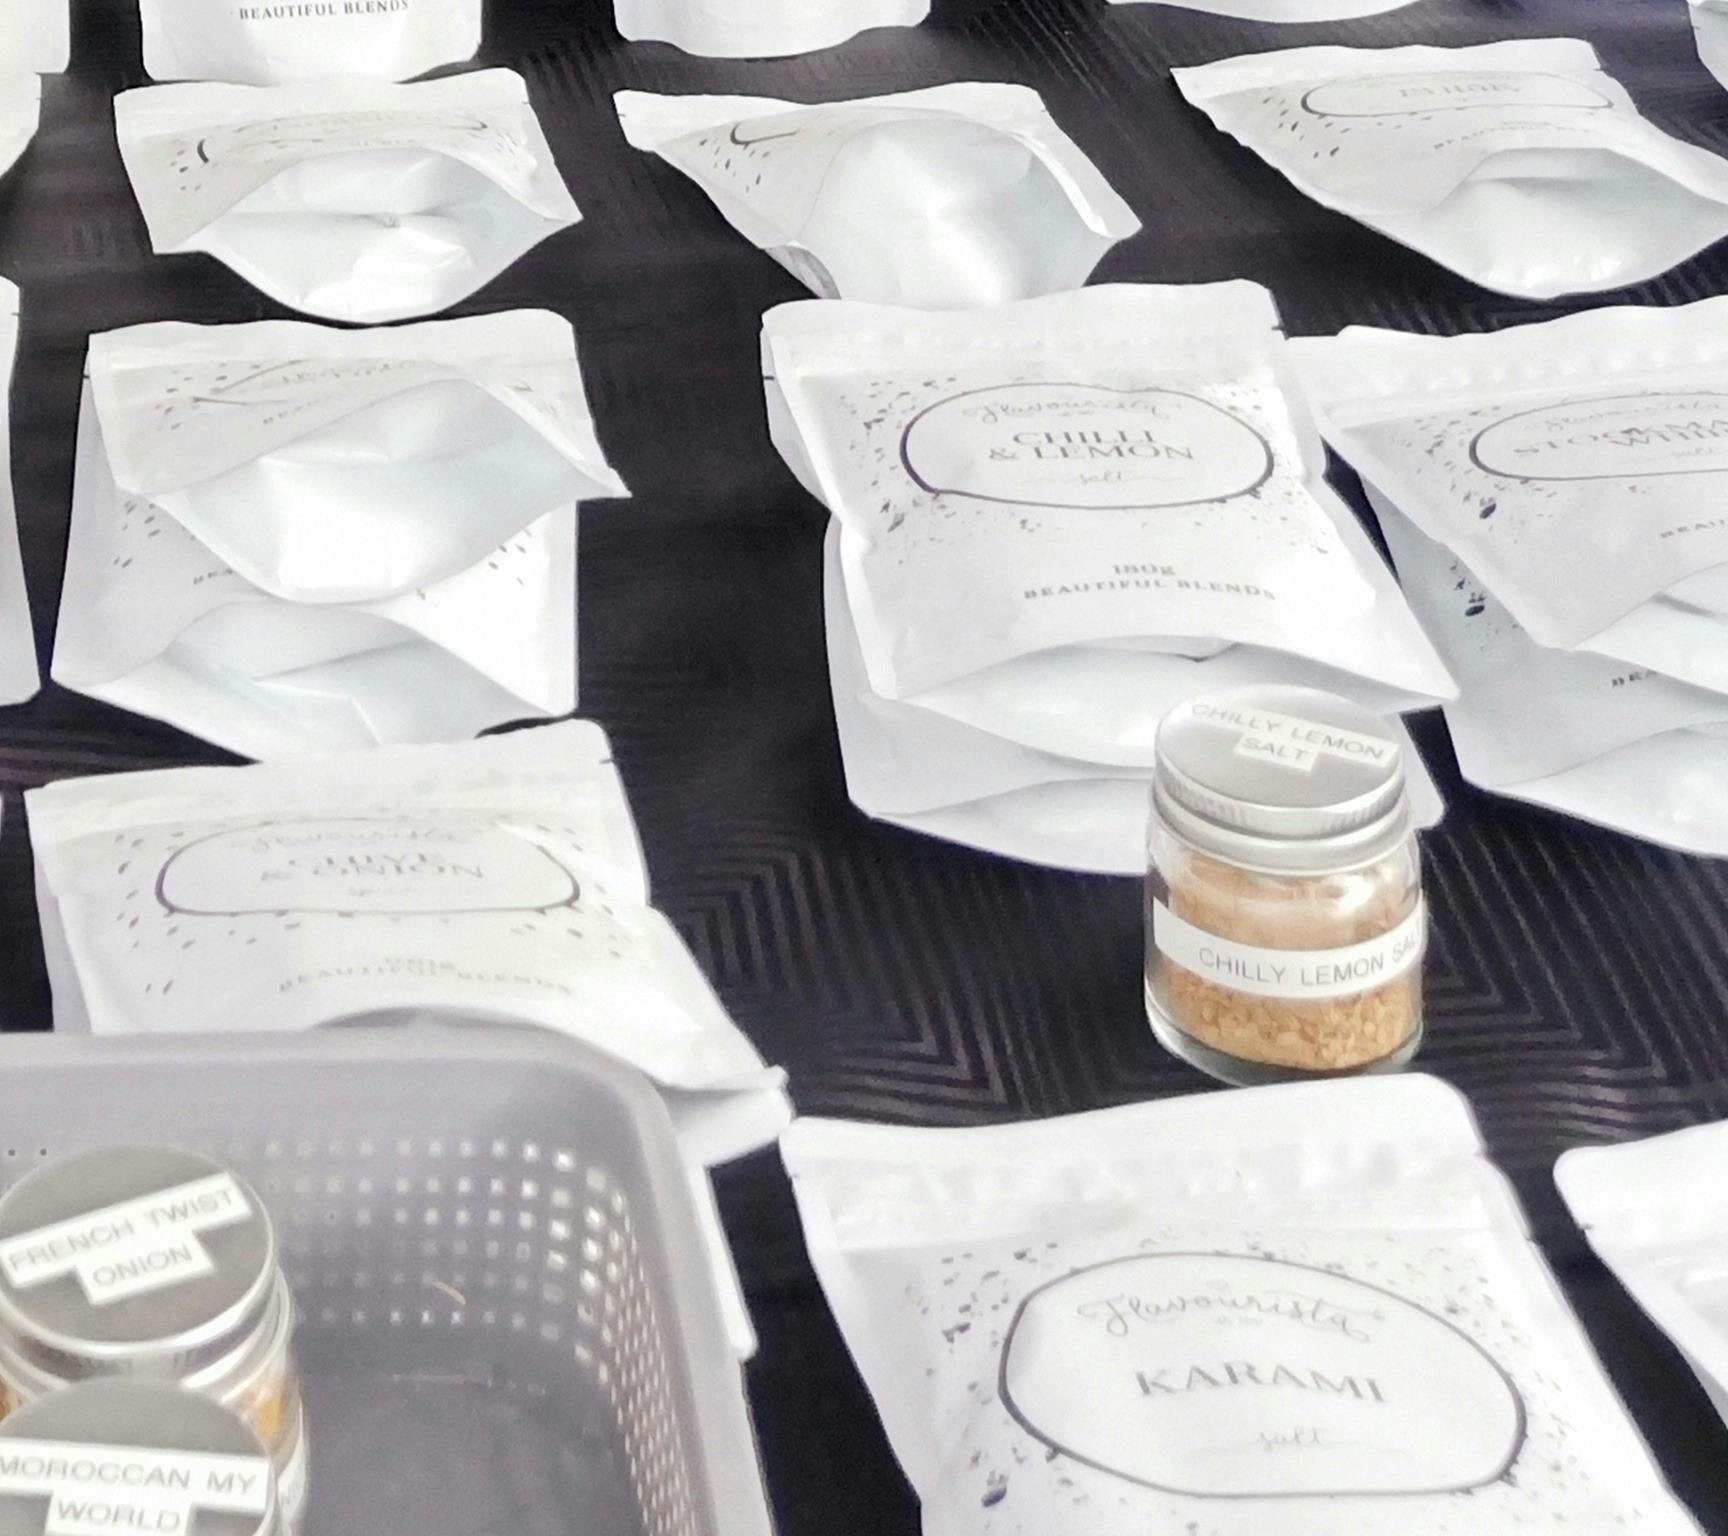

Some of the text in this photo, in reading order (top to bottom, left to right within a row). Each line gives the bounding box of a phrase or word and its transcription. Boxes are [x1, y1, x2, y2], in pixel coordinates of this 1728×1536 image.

[239, 2, 339, 21] BEAUTIFUL
[1012, 429, 1157, 446] CHILLI
[1035, 444, 1195, 462] LEMON
[1023, 580, 1276, 601] BEAUTIFUL BLENDS
[1191, 703, 1385, 760] CHILLY LEMON
[1240, 736, 1309, 762] SALT
[1198, 946, 1386, 986] CHILLY LEMON
[8, 1186, 235, 1273] FRENCH TWIST
[91, 1242, 194, 1288] ONION
[1136, 1362, 1385, 1402] KARAMI
[206, 1471, 257, 1495] MY
[57, 1498, 182, 1531] WORLD
